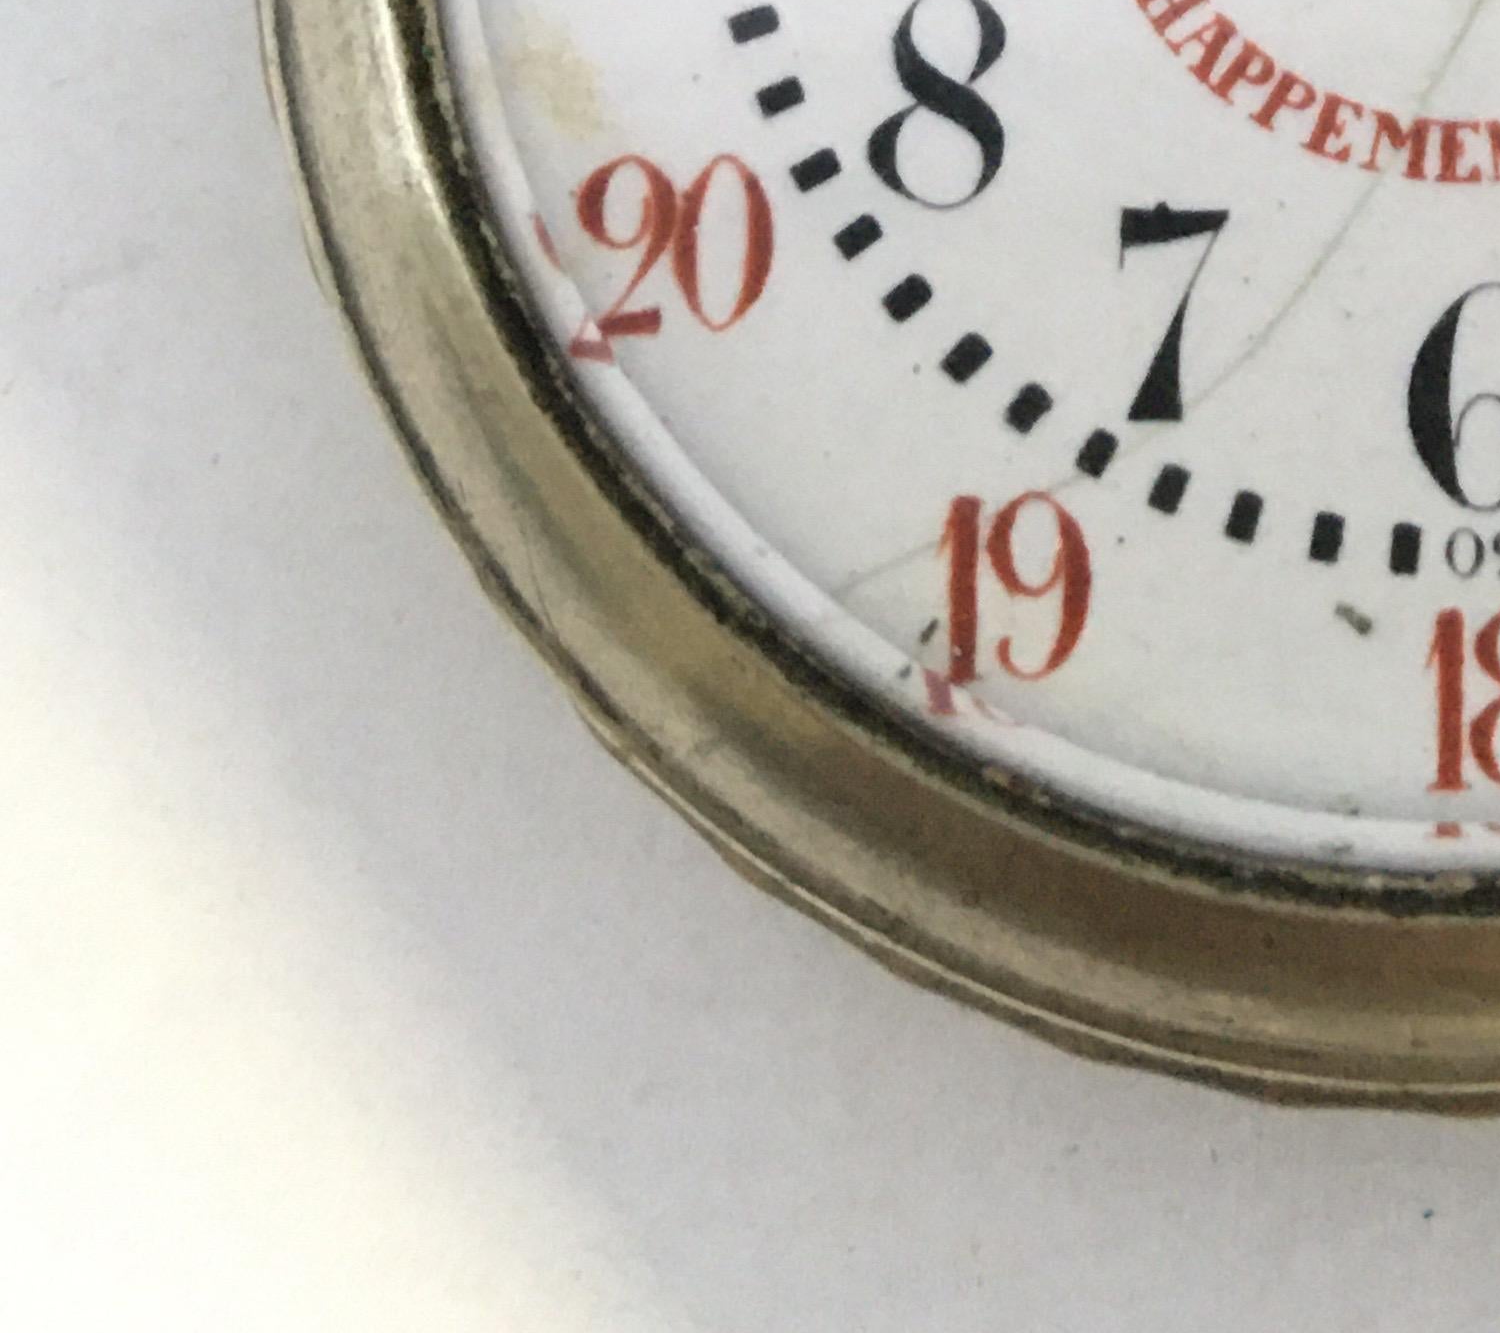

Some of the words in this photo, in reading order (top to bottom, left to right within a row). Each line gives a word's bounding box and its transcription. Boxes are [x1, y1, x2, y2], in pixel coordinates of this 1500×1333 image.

[573, 152, 776, 333] 20
[1119, 201, 1231, 422] 7
[935, 489, 1093, 684] 19
